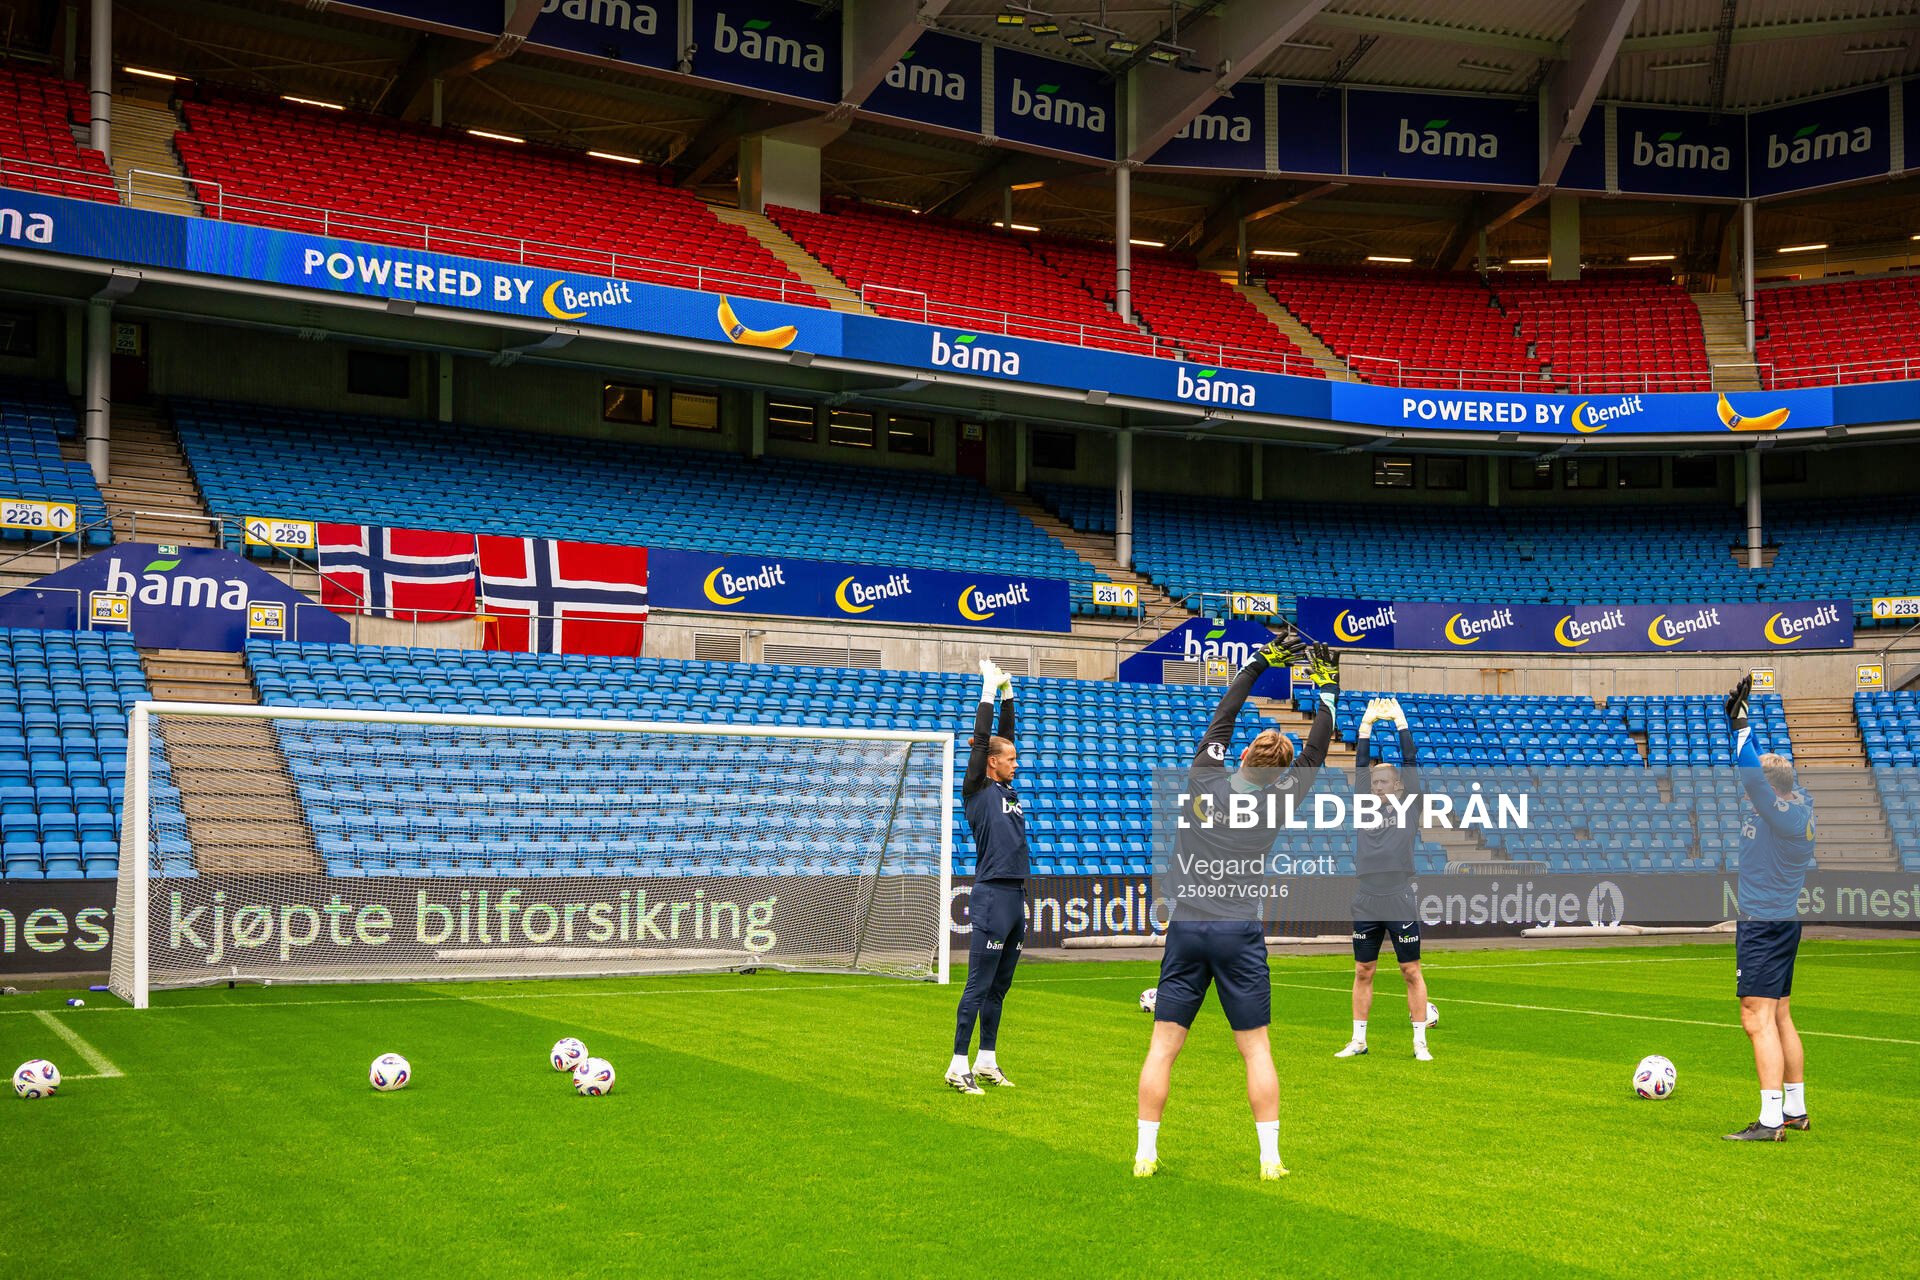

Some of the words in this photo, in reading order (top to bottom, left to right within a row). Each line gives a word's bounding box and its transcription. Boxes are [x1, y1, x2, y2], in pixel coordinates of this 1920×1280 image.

[714, 12, 825, 72] bama
[885, 60, 966, 102] ama
[1011, 78, 1106, 133] bama
[1398, 118, 1499, 159] bama
[1633, 131, 1731, 171] bama
[1767, 126, 1872, 169] bama
[303, 248, 482, 297] POWERED
[494, 276, 534, 304] BY
[563, 281, 632, 310] Bendit
[931, 331, 1020, 375] bama
[1177, 367, 1256, 407] bama
[1403, 398, 1527, 423] POWERED
[1535, 404, 1565, 425] BY
[1587, 395, 1643, 424] Bendit
[6, 508, 43, 526] 228
[15, 503, 33, 511] FELT
[275, 529, 307, 544] 229
[106, 558, 250, 611] bama
[722, 564, 785, 596] Bendit
[852, 573, 912, 604] Bendit
[974, 582, 1030, 612] Bendit
[1098, 590, 1118, 603] 231
[1894, 604, 1919, 615] 233
[1347, 605, 1397, 634] Bendit
[1460, 608, 1514, 637] Bendit
[1569, 609, 1625, 639] Bendit
[1664, 607, 1721, 638] Bendit
[1780, 604, 1840, 636] Bendit
[169, 891, 394, 963] kjøpte
[416, 888, 777, 951] bilforsikring
